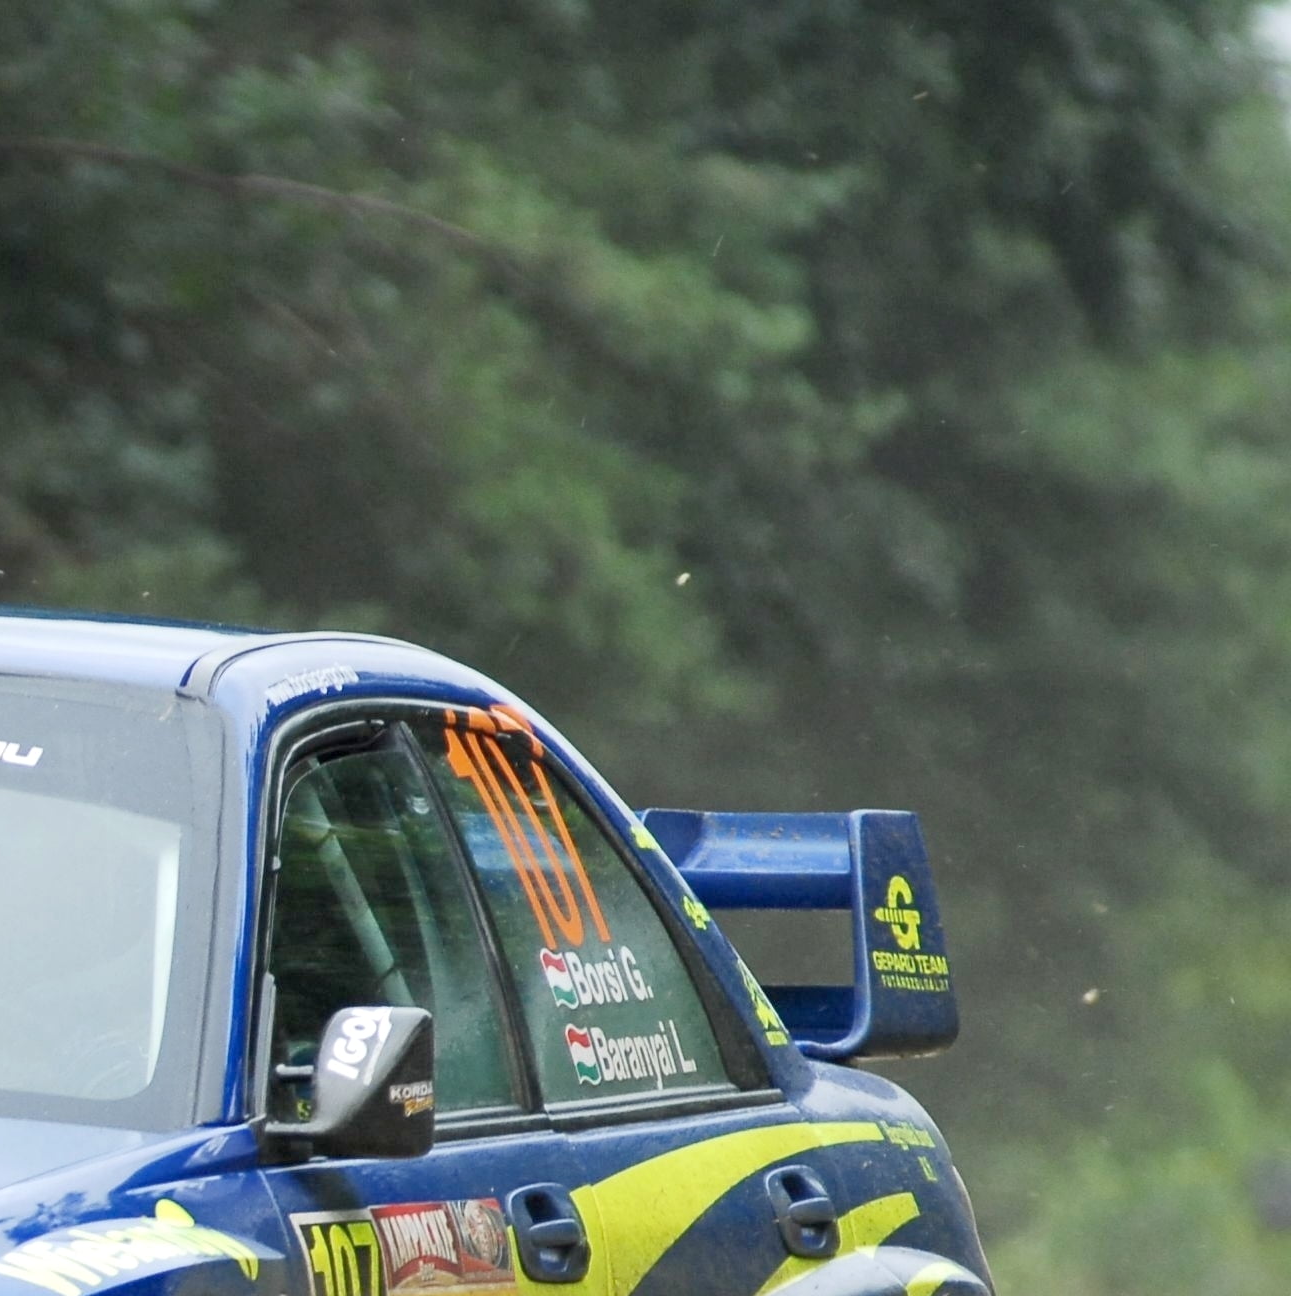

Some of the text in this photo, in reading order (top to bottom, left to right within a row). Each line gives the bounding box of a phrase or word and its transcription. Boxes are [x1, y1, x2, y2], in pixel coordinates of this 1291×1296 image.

[566, 948, 625, 1008] Borsi
[914, 954, 949, 975] TEAM
[591, 1022, 676, 1091] Baranyai
